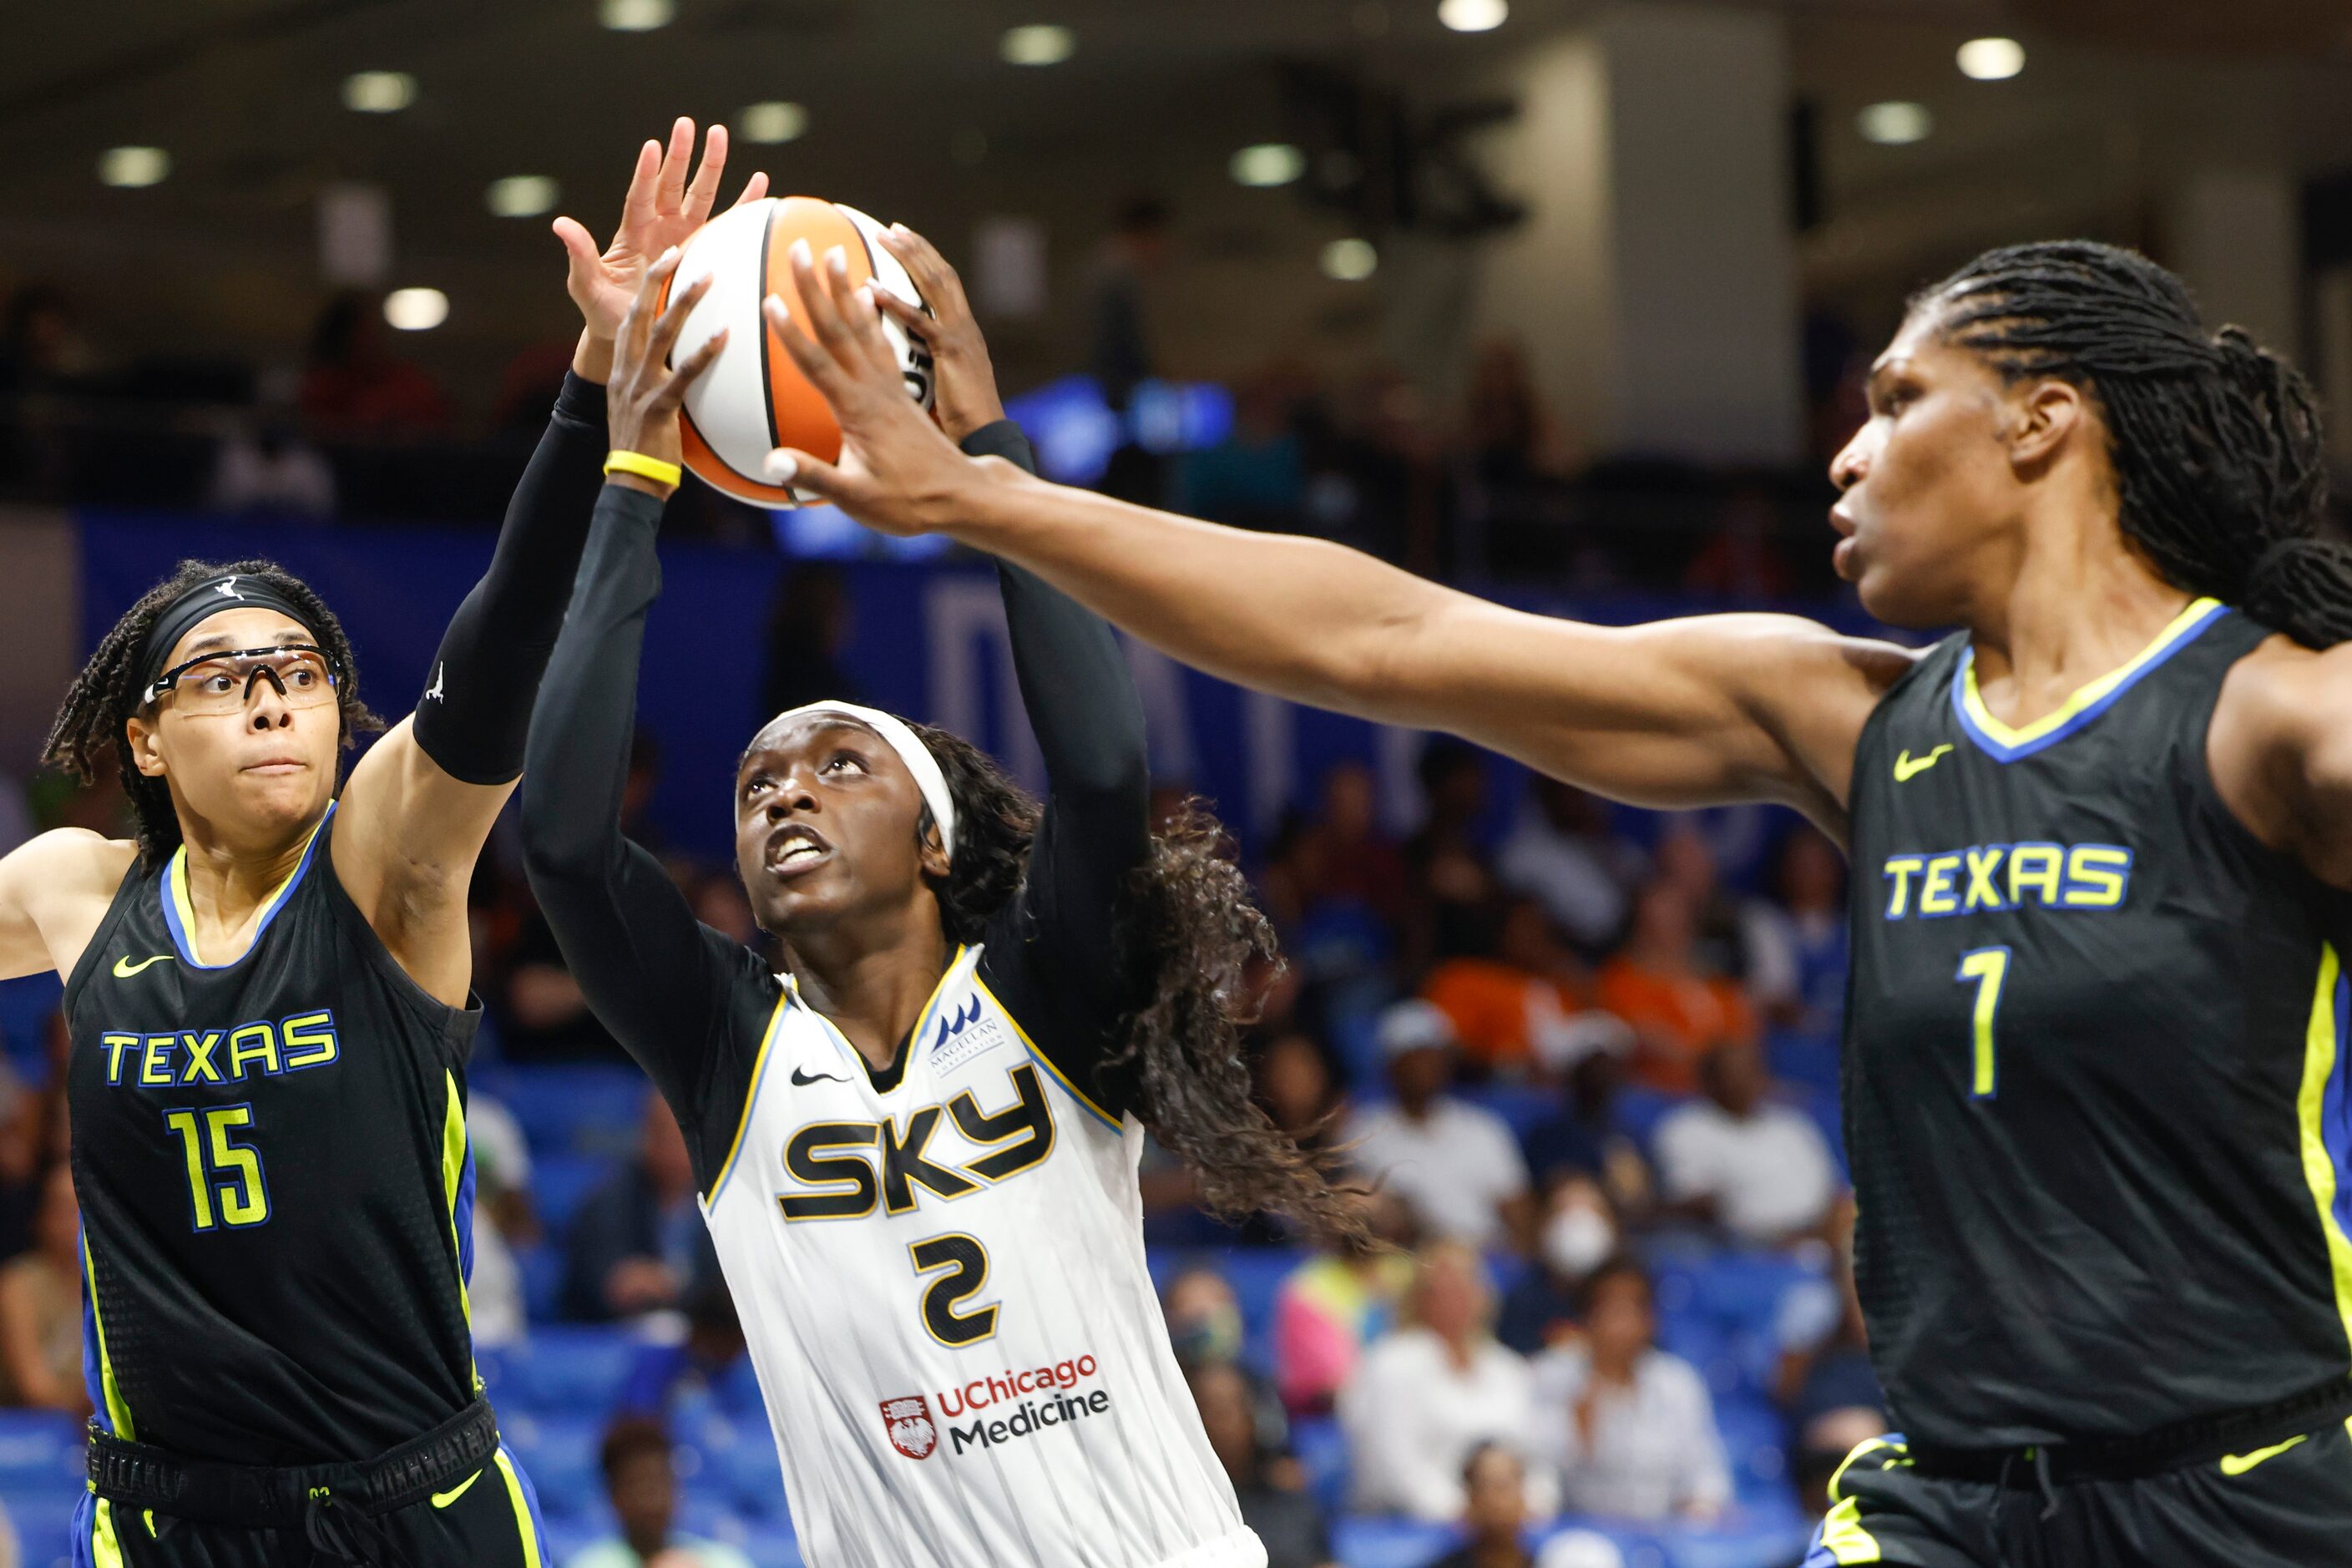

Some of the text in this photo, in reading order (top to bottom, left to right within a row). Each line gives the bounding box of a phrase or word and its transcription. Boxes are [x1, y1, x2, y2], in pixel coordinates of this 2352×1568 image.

[1883, 841, 2133, 920] TEXAS
[100, 1009, 340, 1087] TEXAS
[1955, 945, 2011, 1100] 1
[162, 1101, 272, 1233] 15
[775, 1060, 1056, 1224] SKY
[907, 1231, 1002, 1350] 2
[938, 1354, 1097, 1417] UChicago
[949, 1390, 1109, 1455] Medicine
